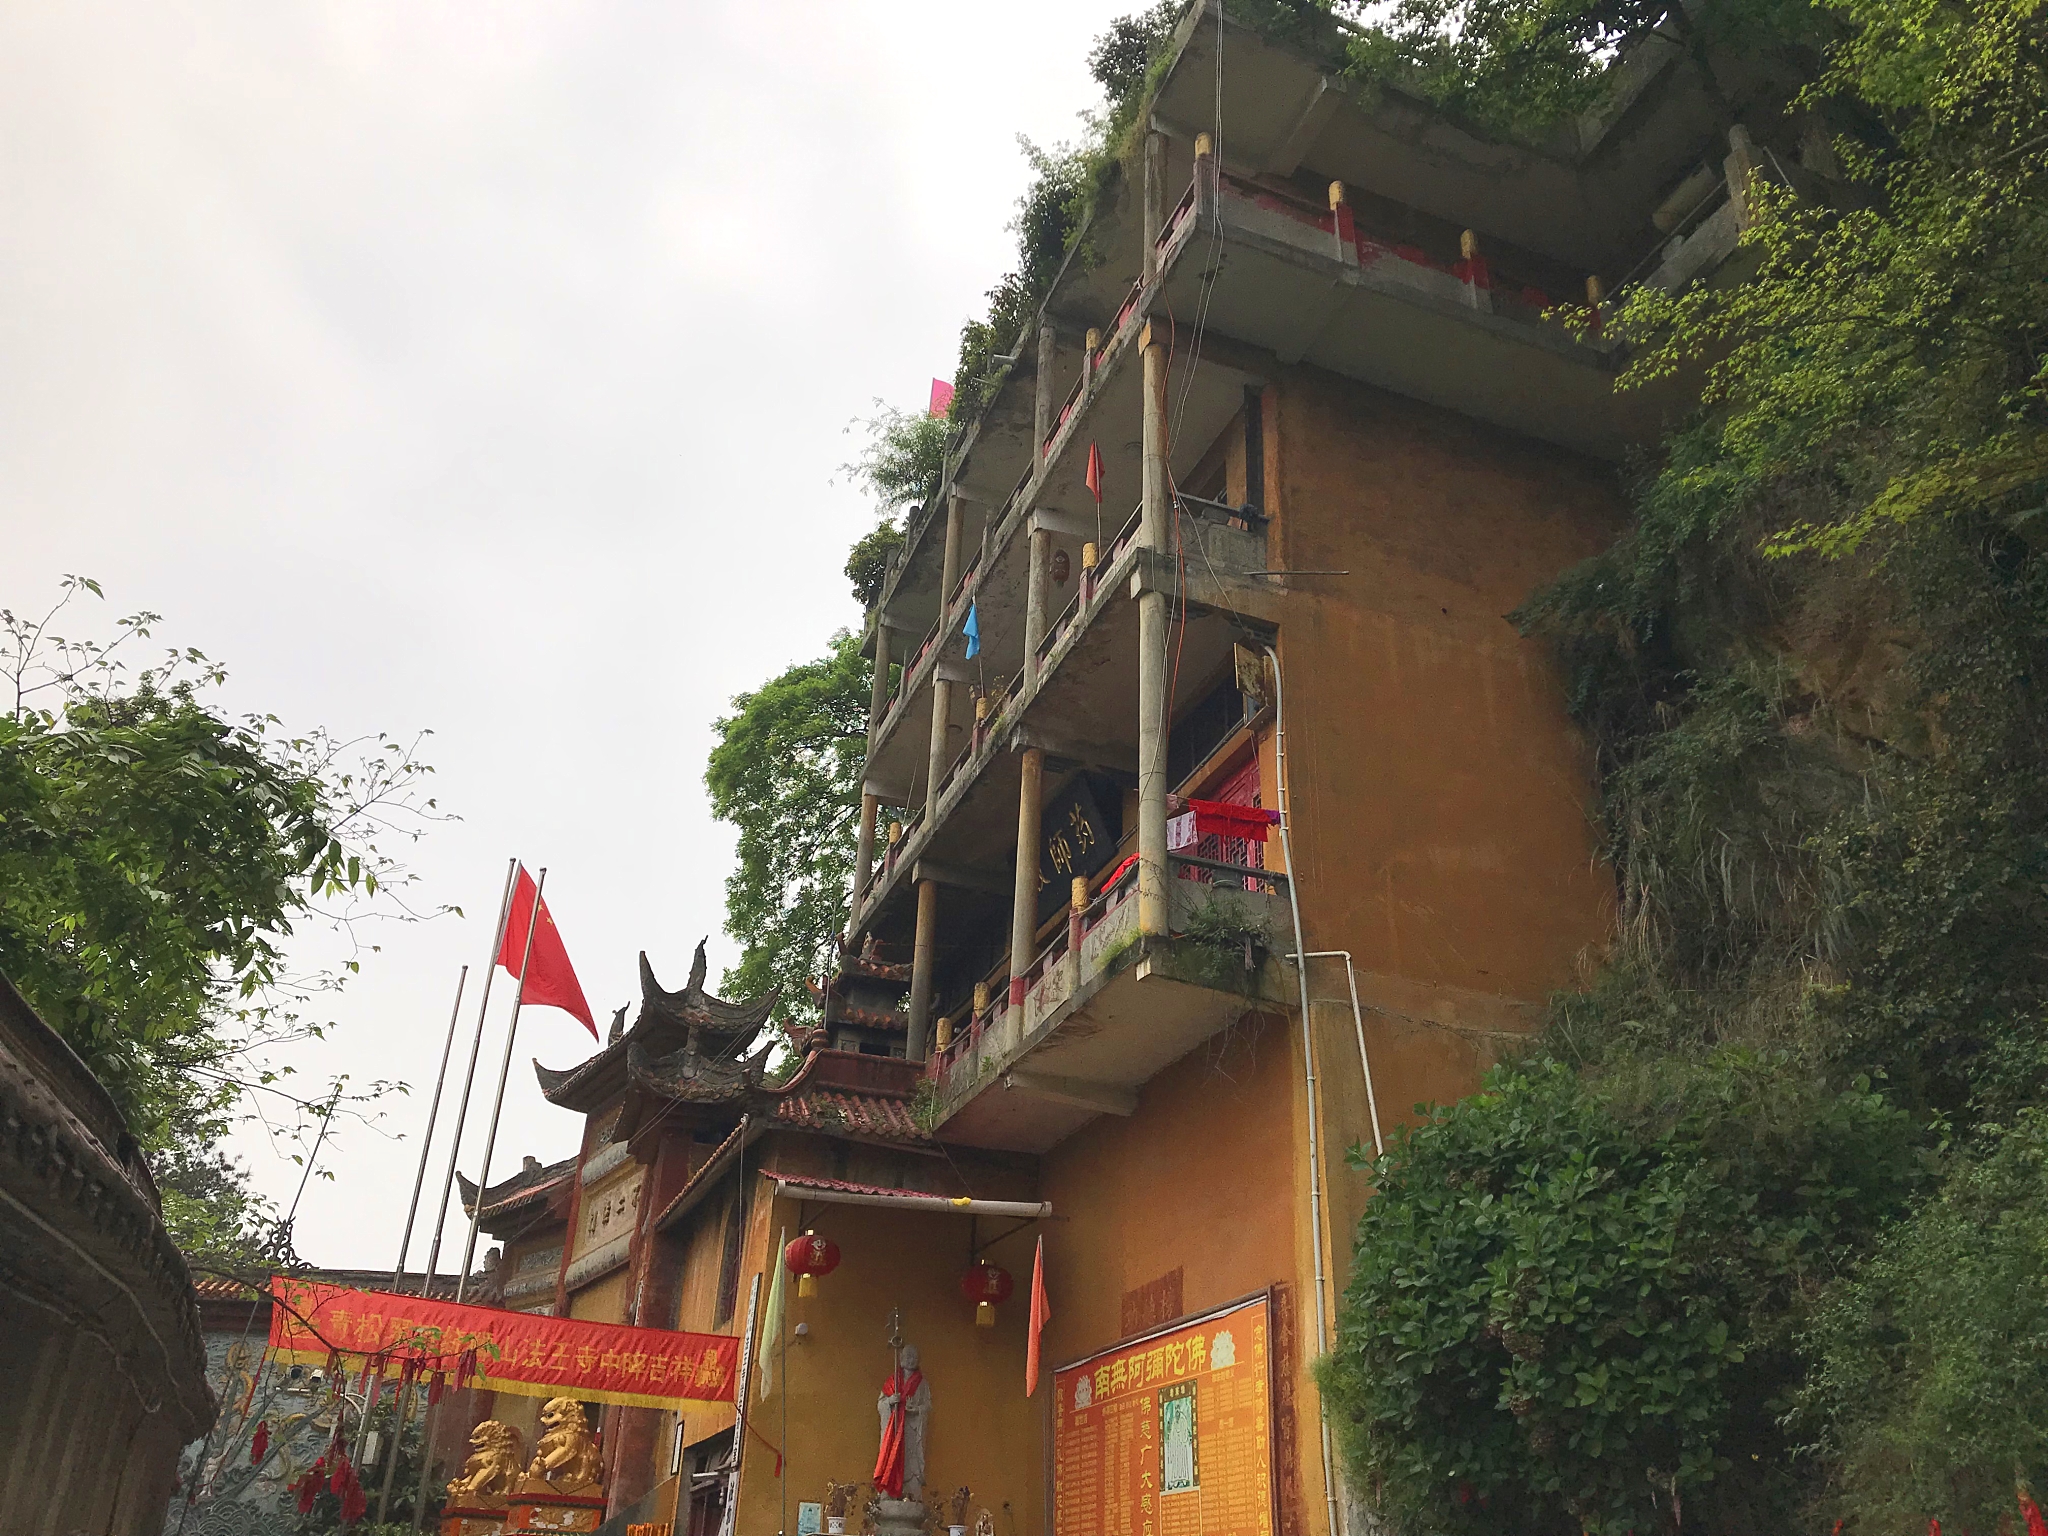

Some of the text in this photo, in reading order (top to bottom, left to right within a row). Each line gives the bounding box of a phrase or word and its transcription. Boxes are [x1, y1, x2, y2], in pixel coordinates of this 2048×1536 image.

[1094, 1334, 1206, 1400] 南無阿彌陀佛
